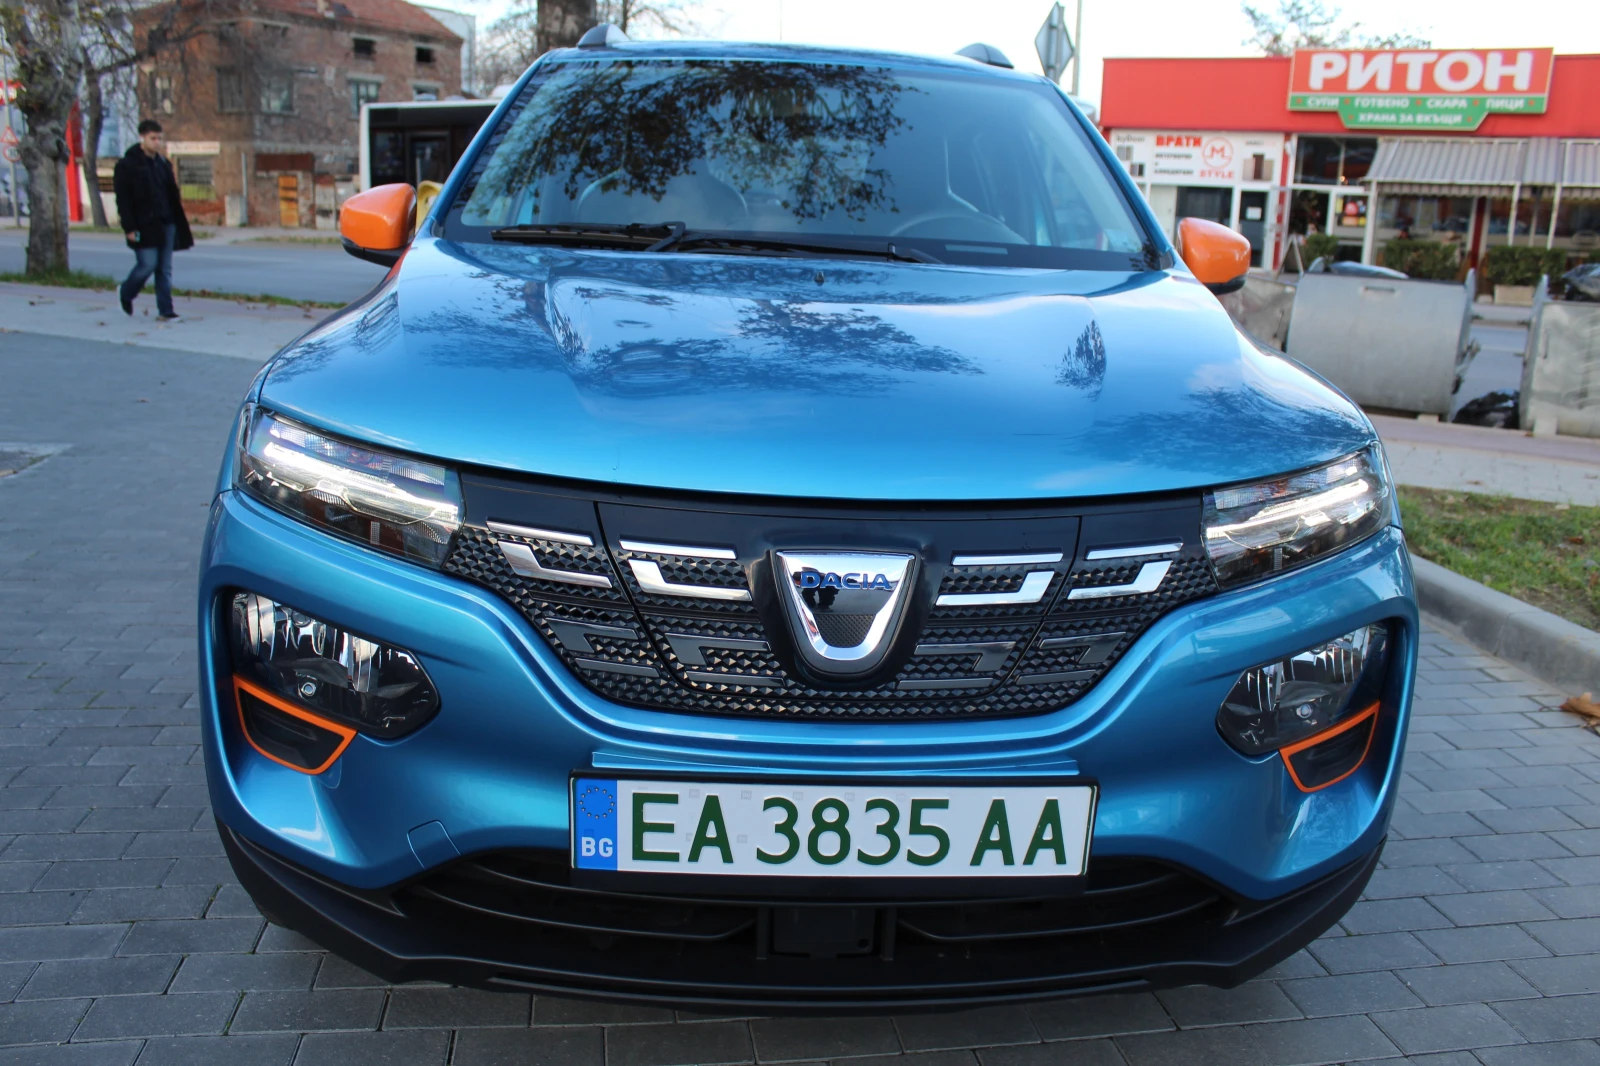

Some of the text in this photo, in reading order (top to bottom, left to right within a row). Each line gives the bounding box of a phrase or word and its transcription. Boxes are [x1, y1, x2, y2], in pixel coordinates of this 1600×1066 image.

[1308, 50, 1534, 92] РИТОН
[1307, 97, 1525, 110] СУПИ ГОТВЕНО СКАРА ПИЦИ
[1358, 111, 1463, 125] ХРАНА ЗА ВКЪЩИ
[1156, 135, 1202, 147] ВРАТИ
[1199, 169, 1235, 180] STYLE
[800, 571, 892, 589] DACIA
[632, 792, 1067, 866] EA 3835 AA
[581, 836, 613, 857] BG
